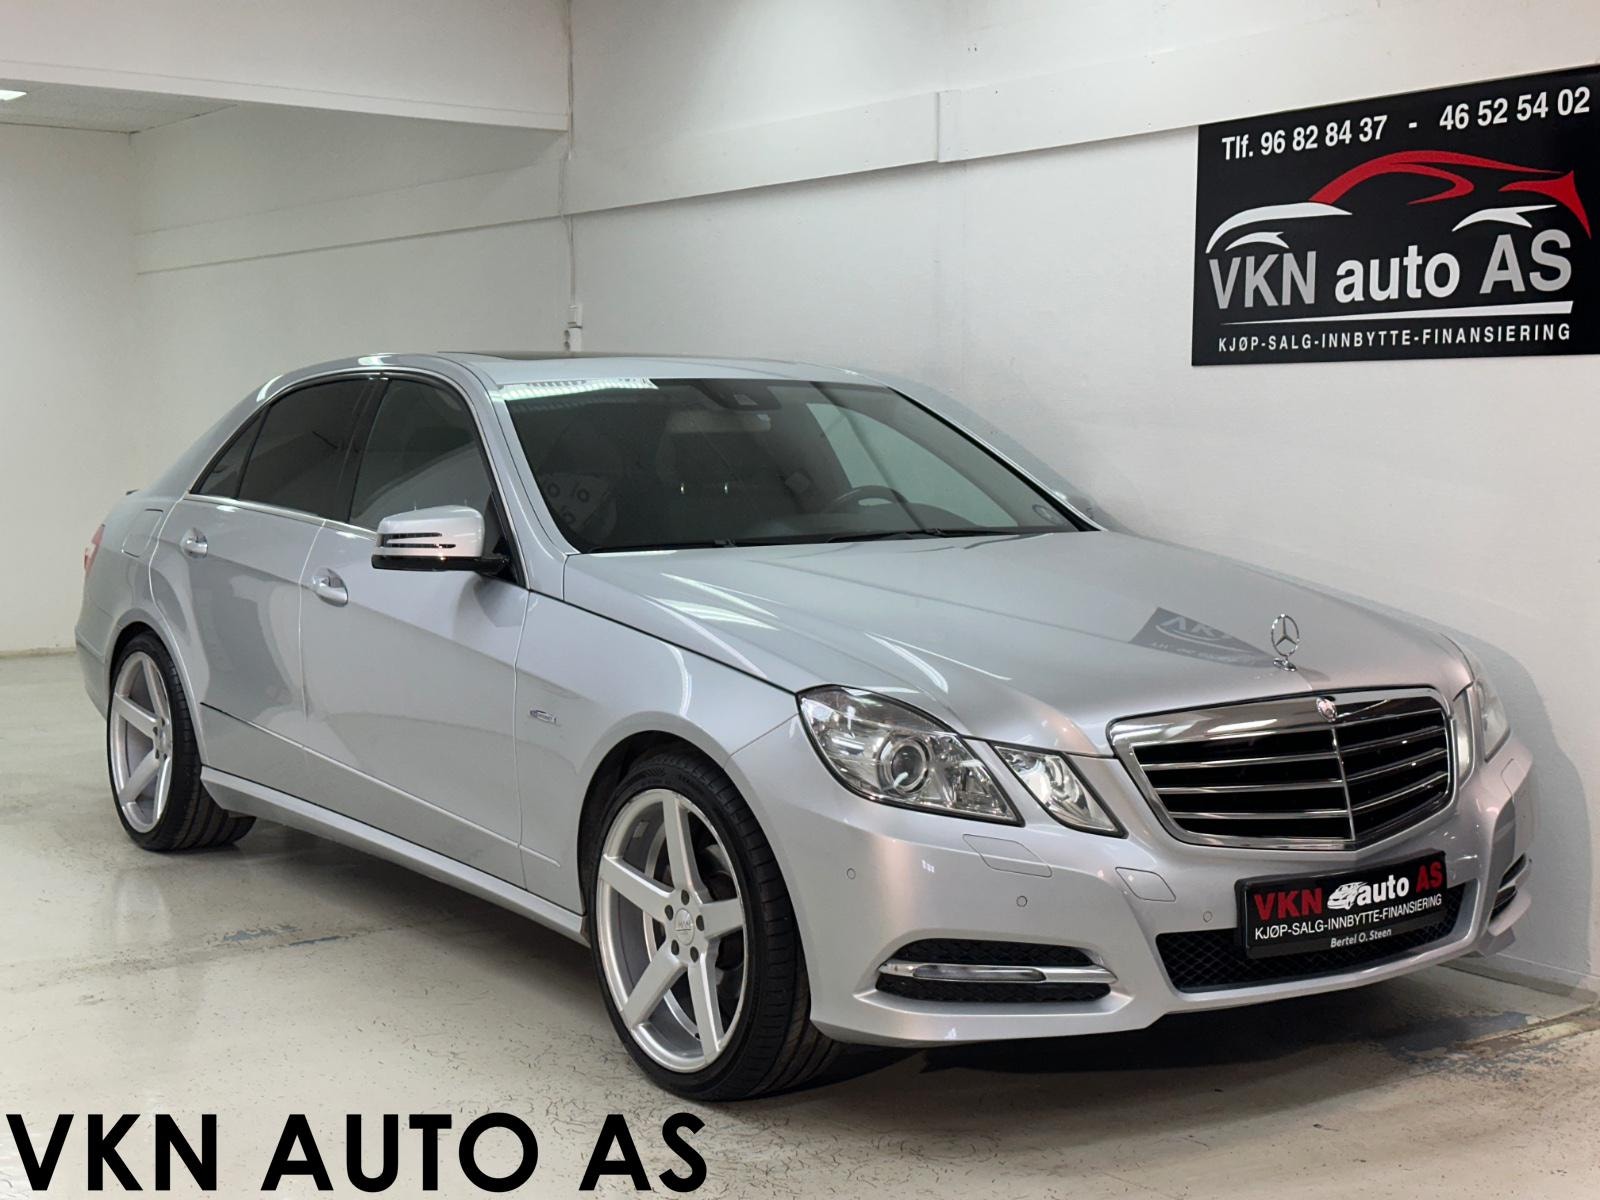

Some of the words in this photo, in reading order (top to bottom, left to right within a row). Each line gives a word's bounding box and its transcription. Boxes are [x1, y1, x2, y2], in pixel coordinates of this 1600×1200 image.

[1222, 134, 1254, 160] Tlf.
[1260, 129, 1286, 156] 96
[1292, 125, 1318, 151] 82
[1325, 120, 1352, 147] 84
[1359, 115, 1388, 142] 37
[1439, 103, 1470, 131] 46
[1477, 98, 1508, 127] 52
[1516, 92, 1549, 122] 54
[1557, 86, 1590, 116] 02
[1208, 251, 1317, 310] VKN
[1334, 244, 1461, 303] auto
[1479, 229, 1572, 294] AS
[1218, 323, 1570, 352] KJØP-SALG-INNBYTTE-FINANSIERING
[1254, 888, 1323, 921] VKN
[1356, 874, 1410, 907] auto
[1415, 861, 1444, 893] AS
[1254, 893, 1443, 940] KJØP-SALG-INNBYTTE-FINANSIERING
[1330, 932, 1357, 948] Bertel
[1358, 932, 1368, 943] O.
[1368, 928, 1392, 941] Steen
